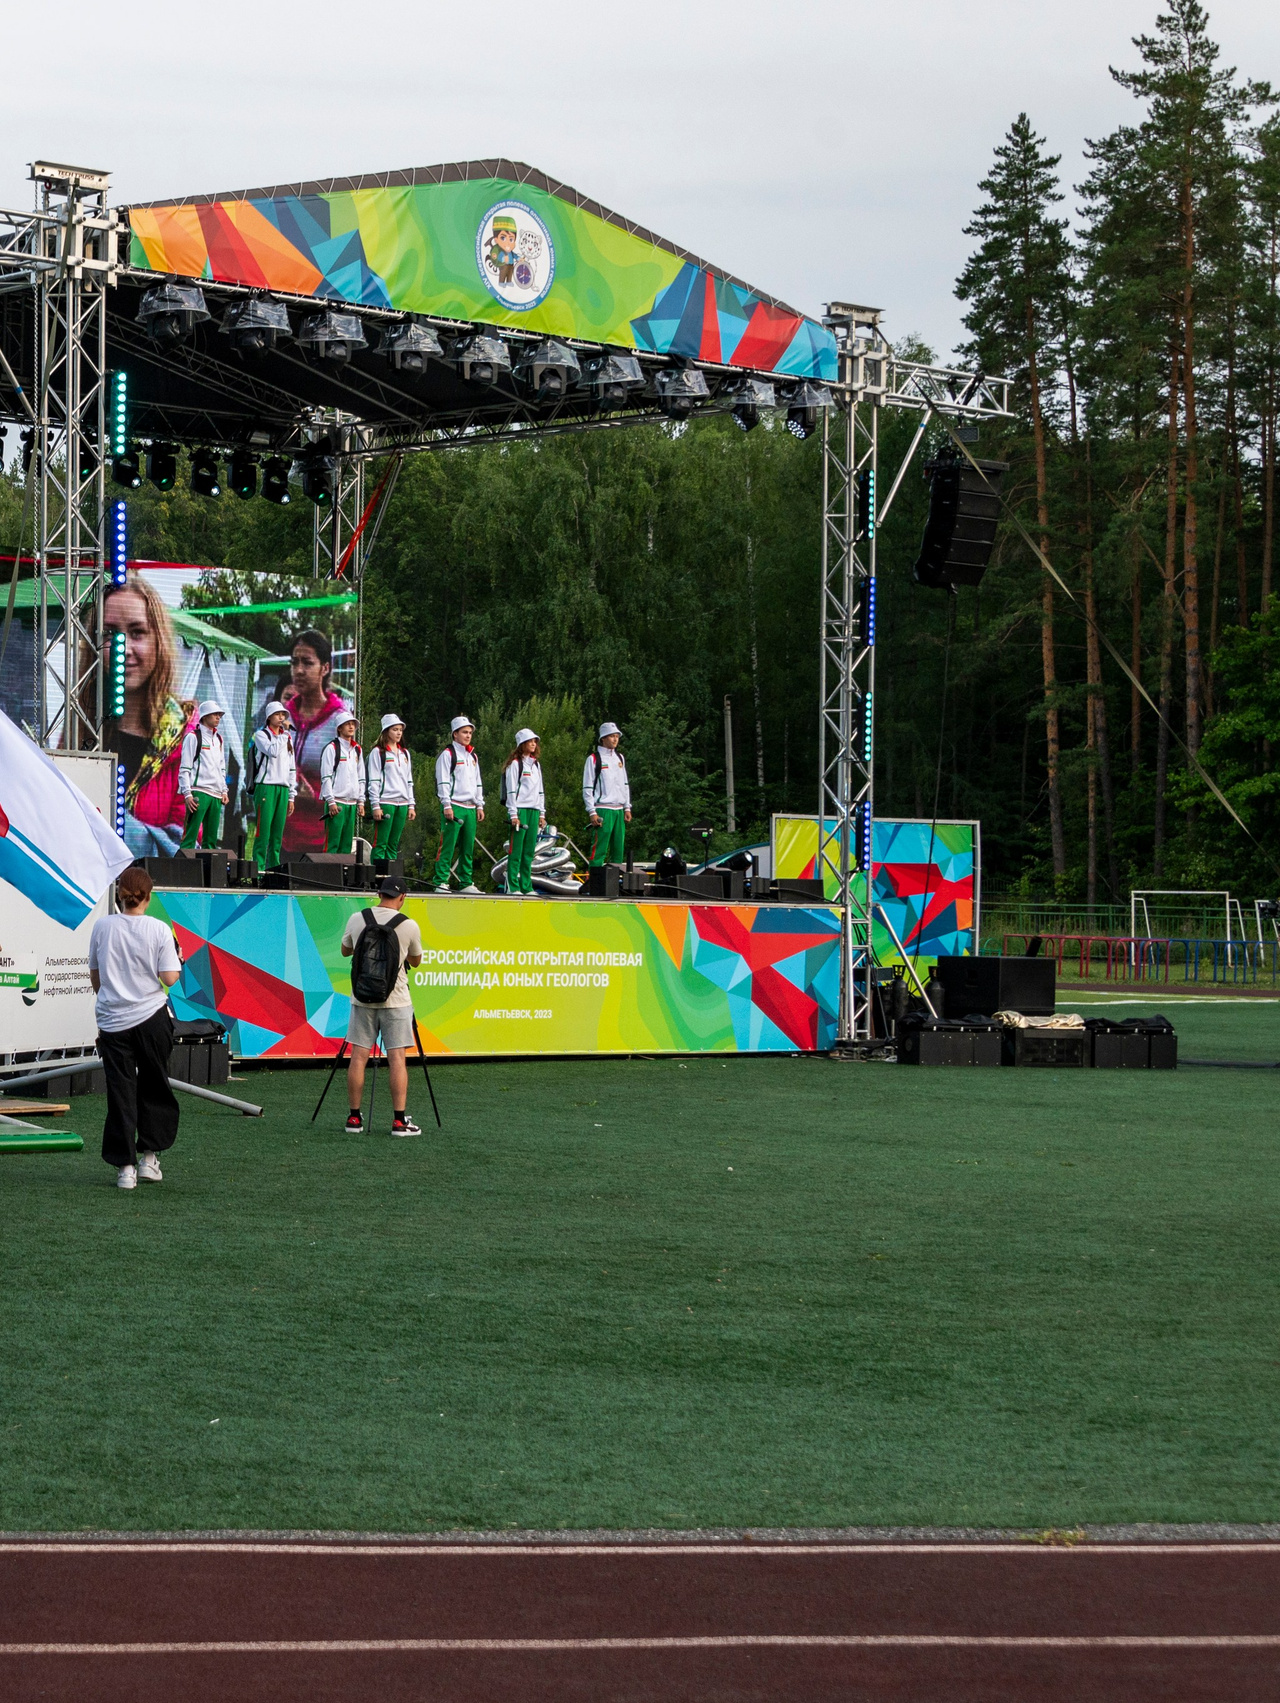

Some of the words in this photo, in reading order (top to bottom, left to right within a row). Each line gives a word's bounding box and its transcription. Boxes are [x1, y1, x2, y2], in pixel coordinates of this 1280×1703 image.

[421, 948, 514, 965] ЕРОССИЙСКАЯ
[518, 950, 583, 966] ОТКРЫТАЯ
[587, 952, 642, 966] ПОЛЕВАЯ
[4, 974, 20, 984] Алтай
[45, 972, 90, 982] государственны
[414, 972, 500, 989] ОЛИМПИАДА
[503, 973, 543, 987] ЮНЫХ
[546, 973, 610, 988] ГЕОЛОГОВ
[44, 985, 72, 998] нефтяной
[74, 986, 95, 996] институ
[474, 1010, 532, 1020] АЛЬМЕТЬЕВСК,
[534, 1010, 552, 1018] 2023
